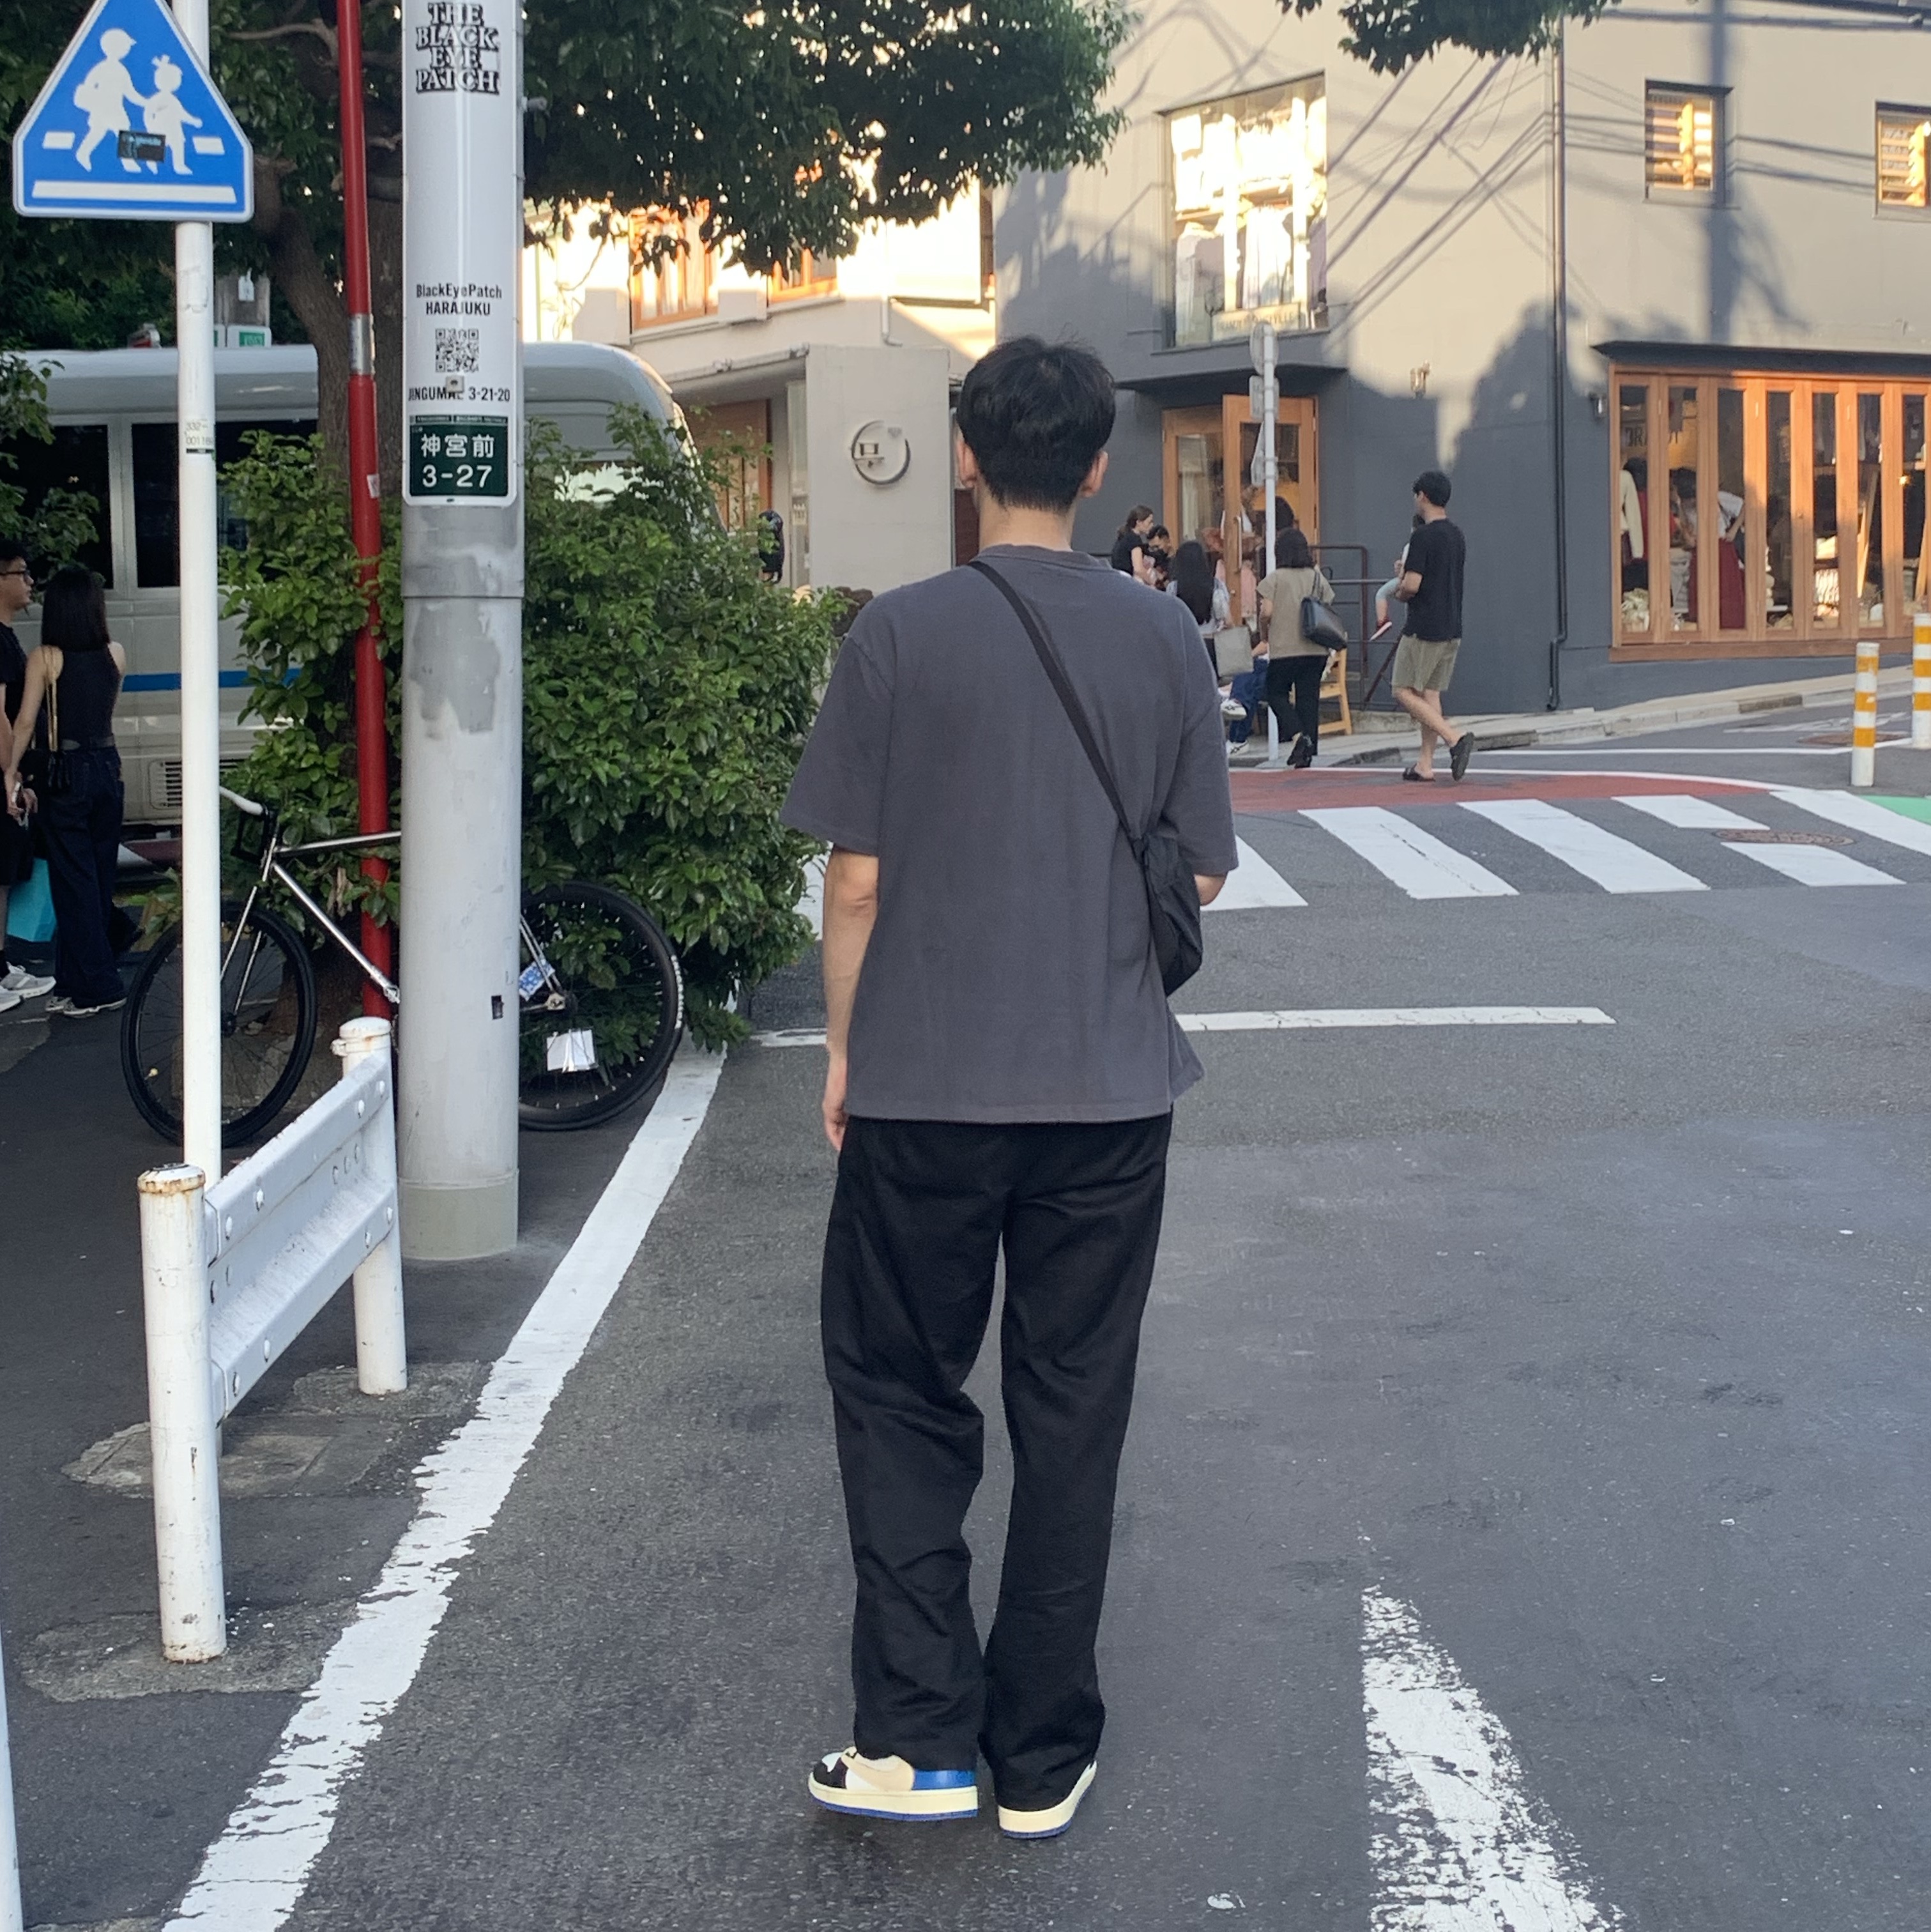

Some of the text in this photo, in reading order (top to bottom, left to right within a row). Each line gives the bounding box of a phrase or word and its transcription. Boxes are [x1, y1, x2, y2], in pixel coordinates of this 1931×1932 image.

[427, 2, 484, 26] THE
[416, 25, 499, 52] BLACK
[430, 46, 482, 69] EYE
[416, 68, 500, 95] PATCH
[416, 283, 503, 299] BlackEyePatch
[425, 302, 491, 315] HARAJUKU
[421, 433, 494, 458] 神宮前
[422, 464, 492, 487] 3-27
